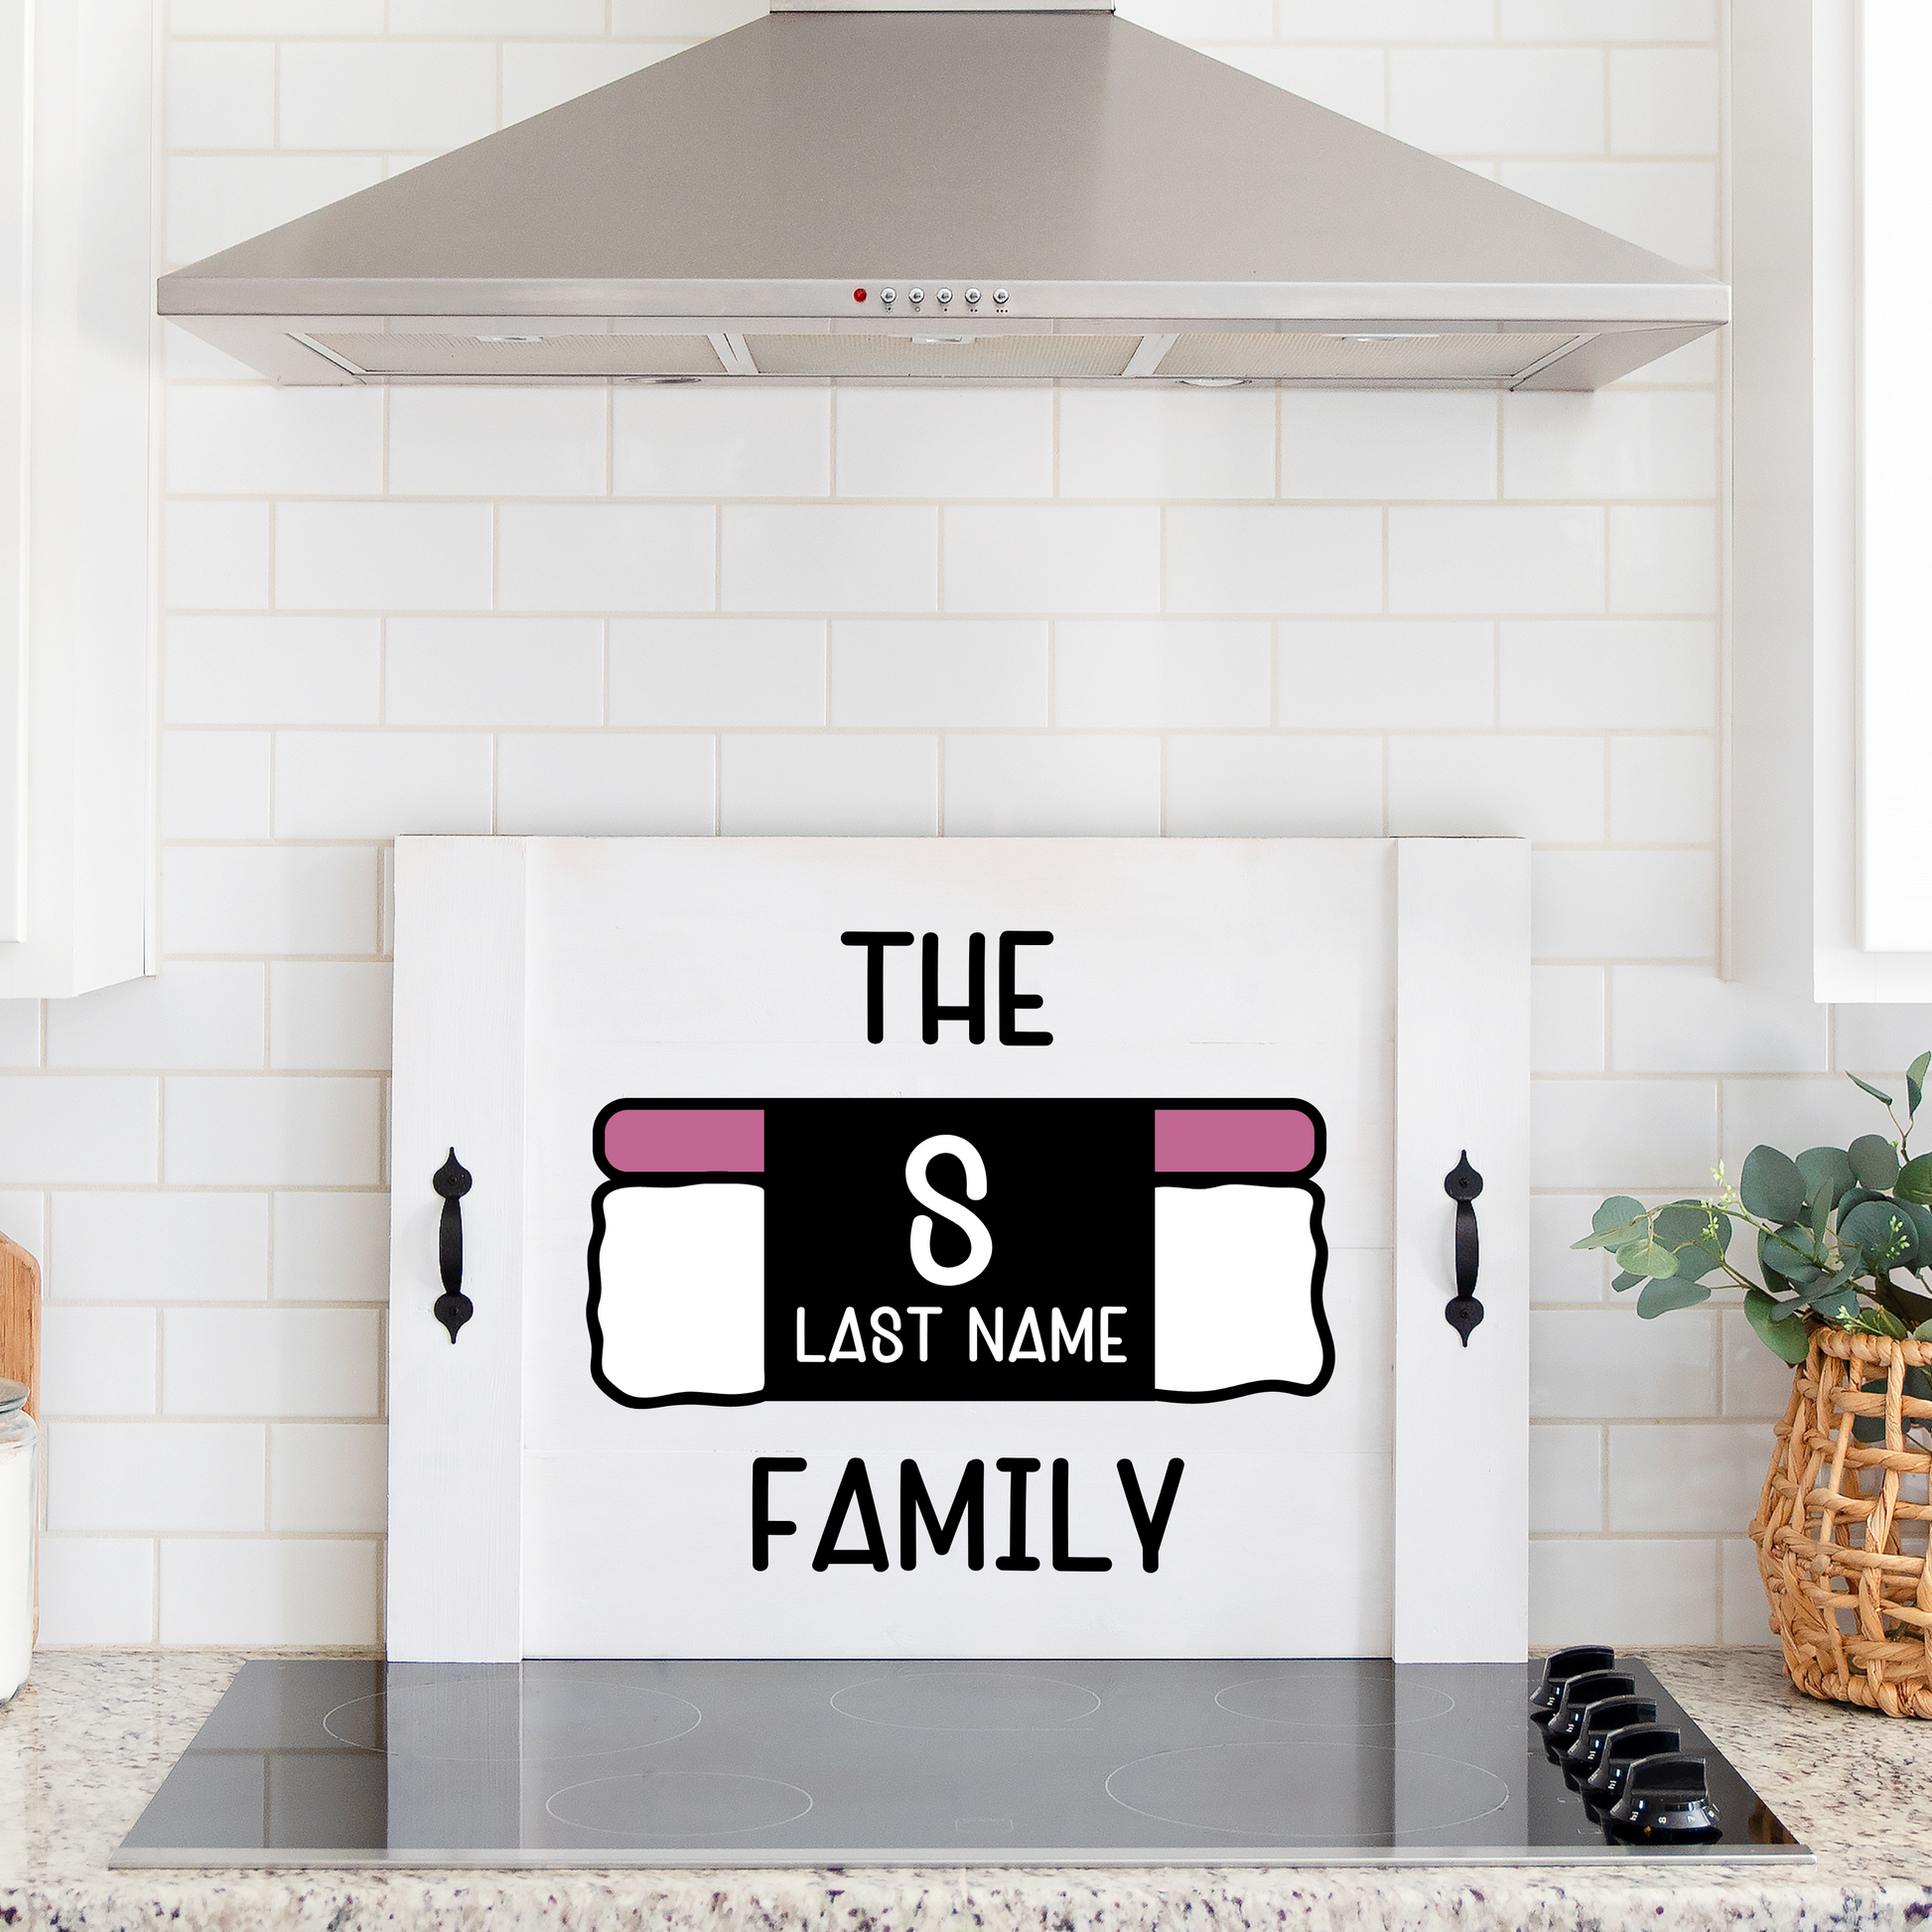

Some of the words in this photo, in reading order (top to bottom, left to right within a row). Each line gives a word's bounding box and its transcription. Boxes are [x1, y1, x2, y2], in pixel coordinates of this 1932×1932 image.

[840, 929, 1054, 1046] THE
[904, 1134, 993, 1287] S
[796, 1306, 943, 1364] LAST
[968, 1306, 1128, 1363] NAME
[752, 1456, 1185, 1574] FAMILY
